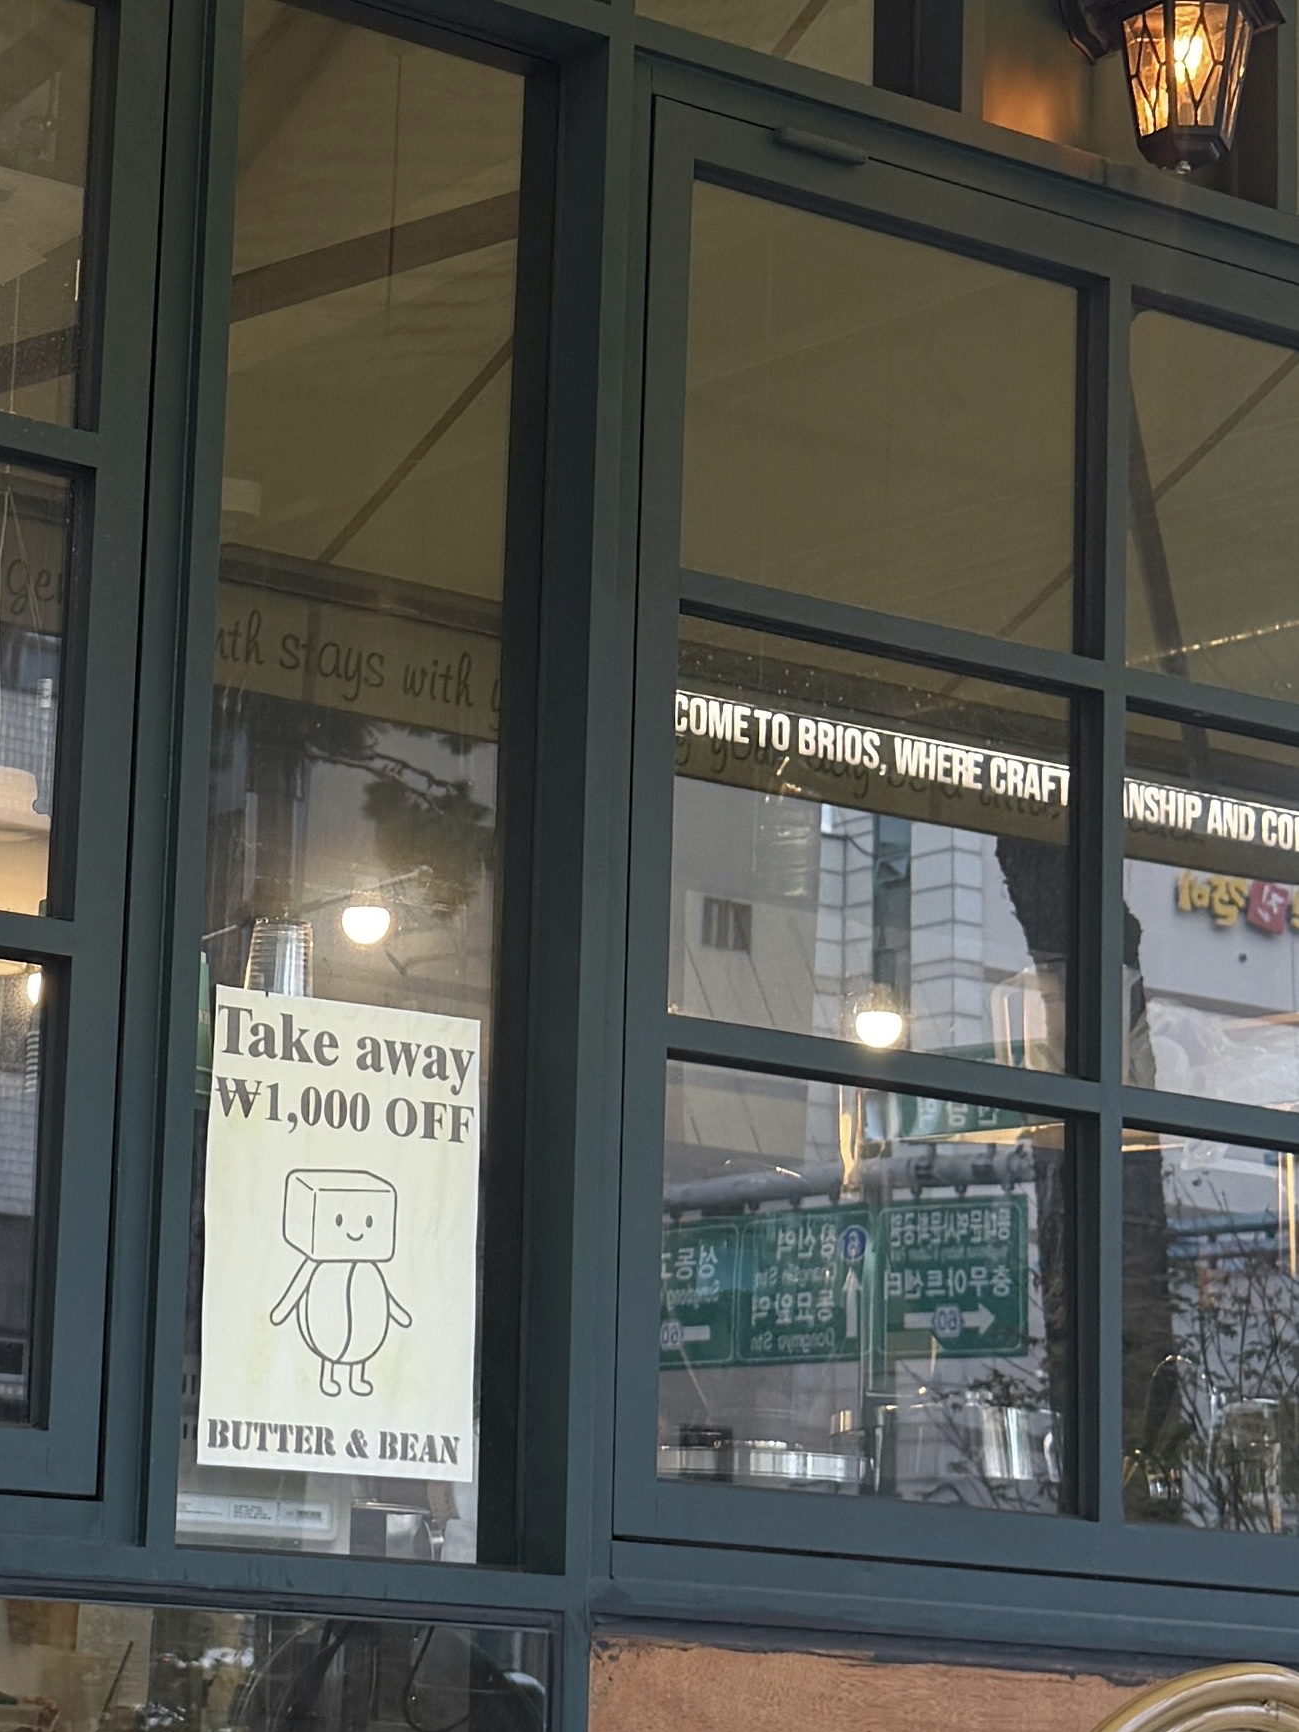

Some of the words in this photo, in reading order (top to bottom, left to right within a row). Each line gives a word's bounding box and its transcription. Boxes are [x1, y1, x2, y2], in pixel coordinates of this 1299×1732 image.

[6, 557, 63, 616] ge
[278, 632, 386, 701] stays
[403, 651, 474, 707] with
[754, 709, 790, 752] TO
[799, 718, 887, 776] BRIOS,
[894, 735, 984, 791] WHERE
[990, 756, 1070, 807] CRAFT
[1206, 799, 1256, 843] AND
[218, 1004, 340, 1067] Take
[355, 1035, 475, 1096] away
[385, 1097, 475, 1144] OFF
[207, 1418, 336, 1457] BUTTER
[345, 1428, 370, 1459] &
[378, 1430, 460, 1465] BEAN
